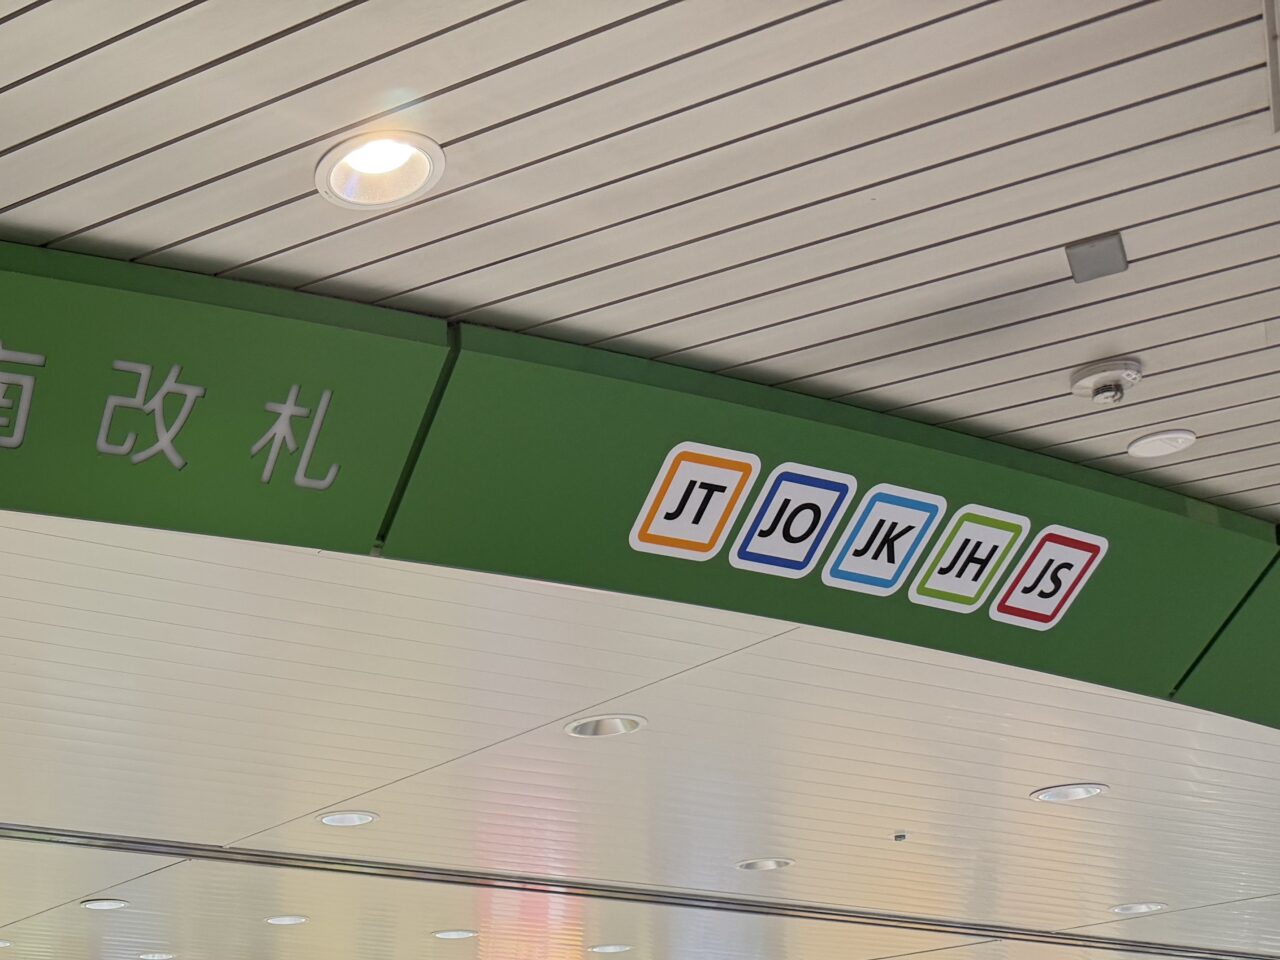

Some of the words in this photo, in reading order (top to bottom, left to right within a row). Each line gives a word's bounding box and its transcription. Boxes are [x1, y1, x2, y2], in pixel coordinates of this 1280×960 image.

[664, 479, 728, 526] JT
[757, 497, 822, 544] JO
[852, 517, 916, 565] JK
[937, 536, 1000, 583] JH
[1021, 557, 1075, 600] JS
